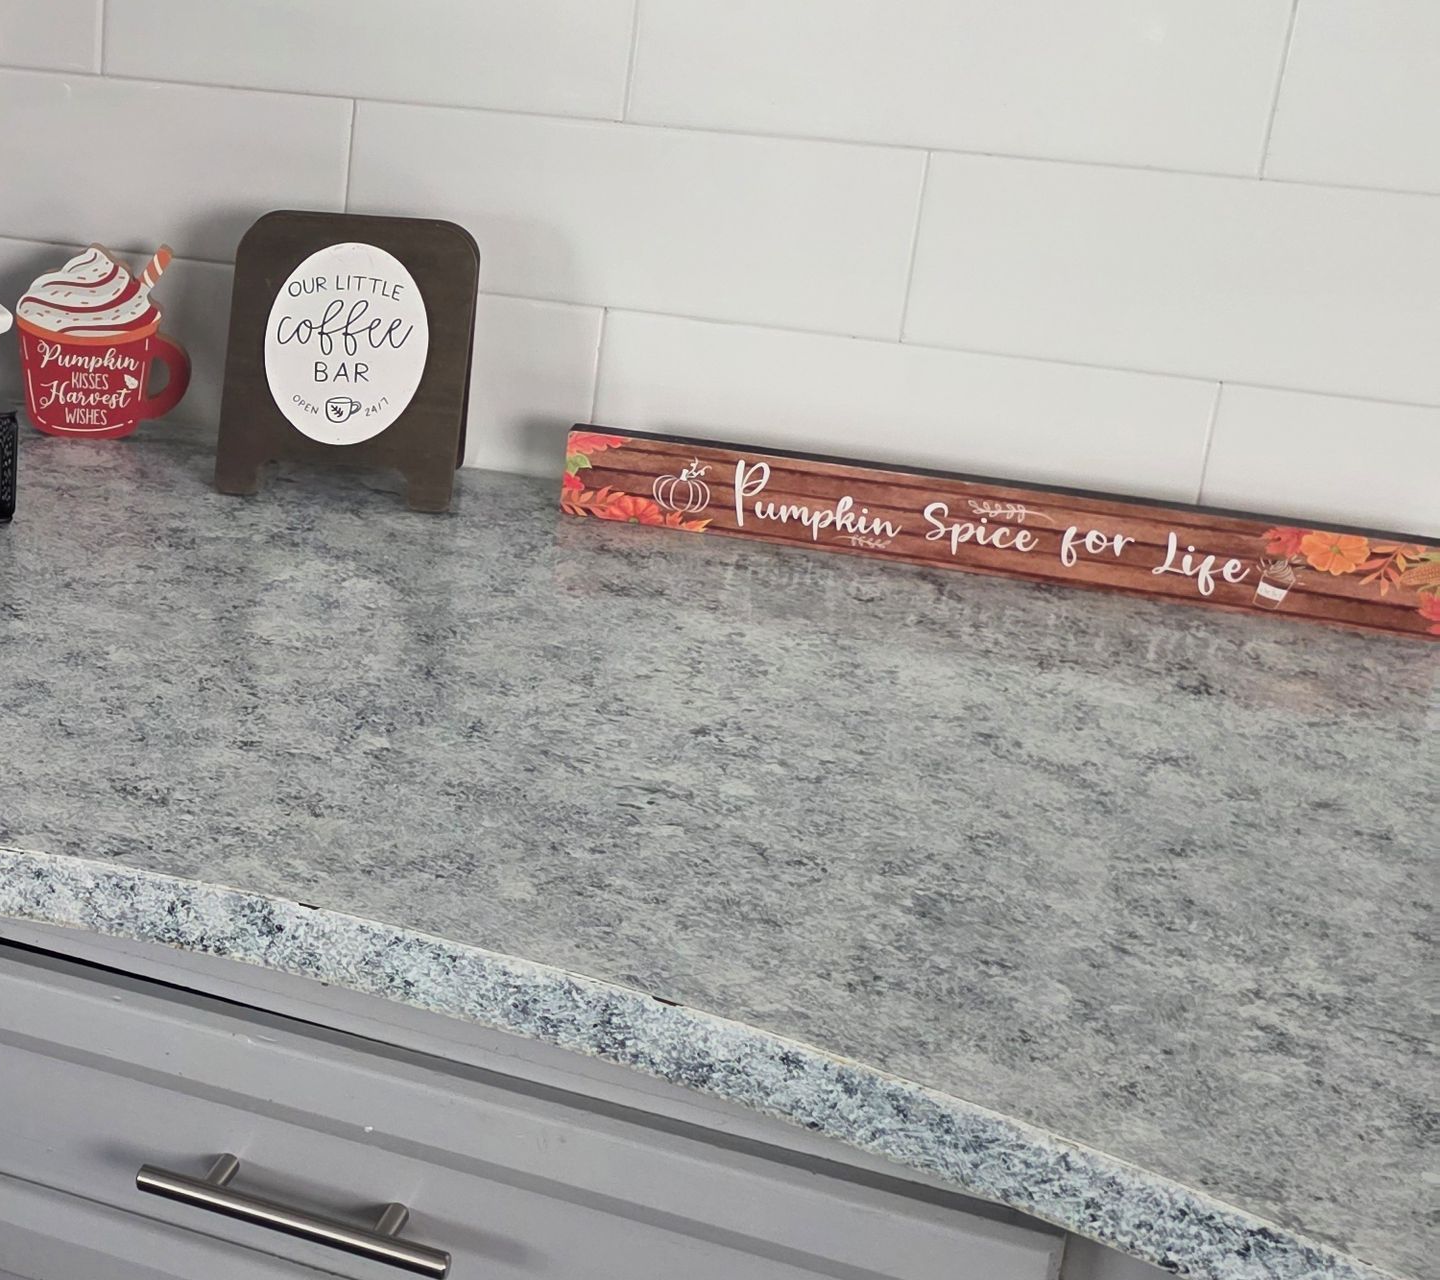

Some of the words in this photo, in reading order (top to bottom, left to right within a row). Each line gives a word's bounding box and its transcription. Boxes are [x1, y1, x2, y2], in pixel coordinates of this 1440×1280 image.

[288, 276, 327, 297] OUR
[336, 275, 405, 301] LITTLE
[277, 299, 414, 356] coffee
[37, 339, 140, 373] Pumpkin
[71, 371, 109, 390] KISSES
[314, 361, 369, 383] BAR
[40, 380, 132, 409] Harvest
[292, 394, 320, 415] OPEN
[364, 396, 390, 417] 24/7
[65, 407, 108, 426] WISHES
[733, 459, 902, 541] Pumpkin
[923, 502, 1039, 556] Spice
[1060, 526, 1135, 568] for
[1151, 531, 1251, 596] Life
